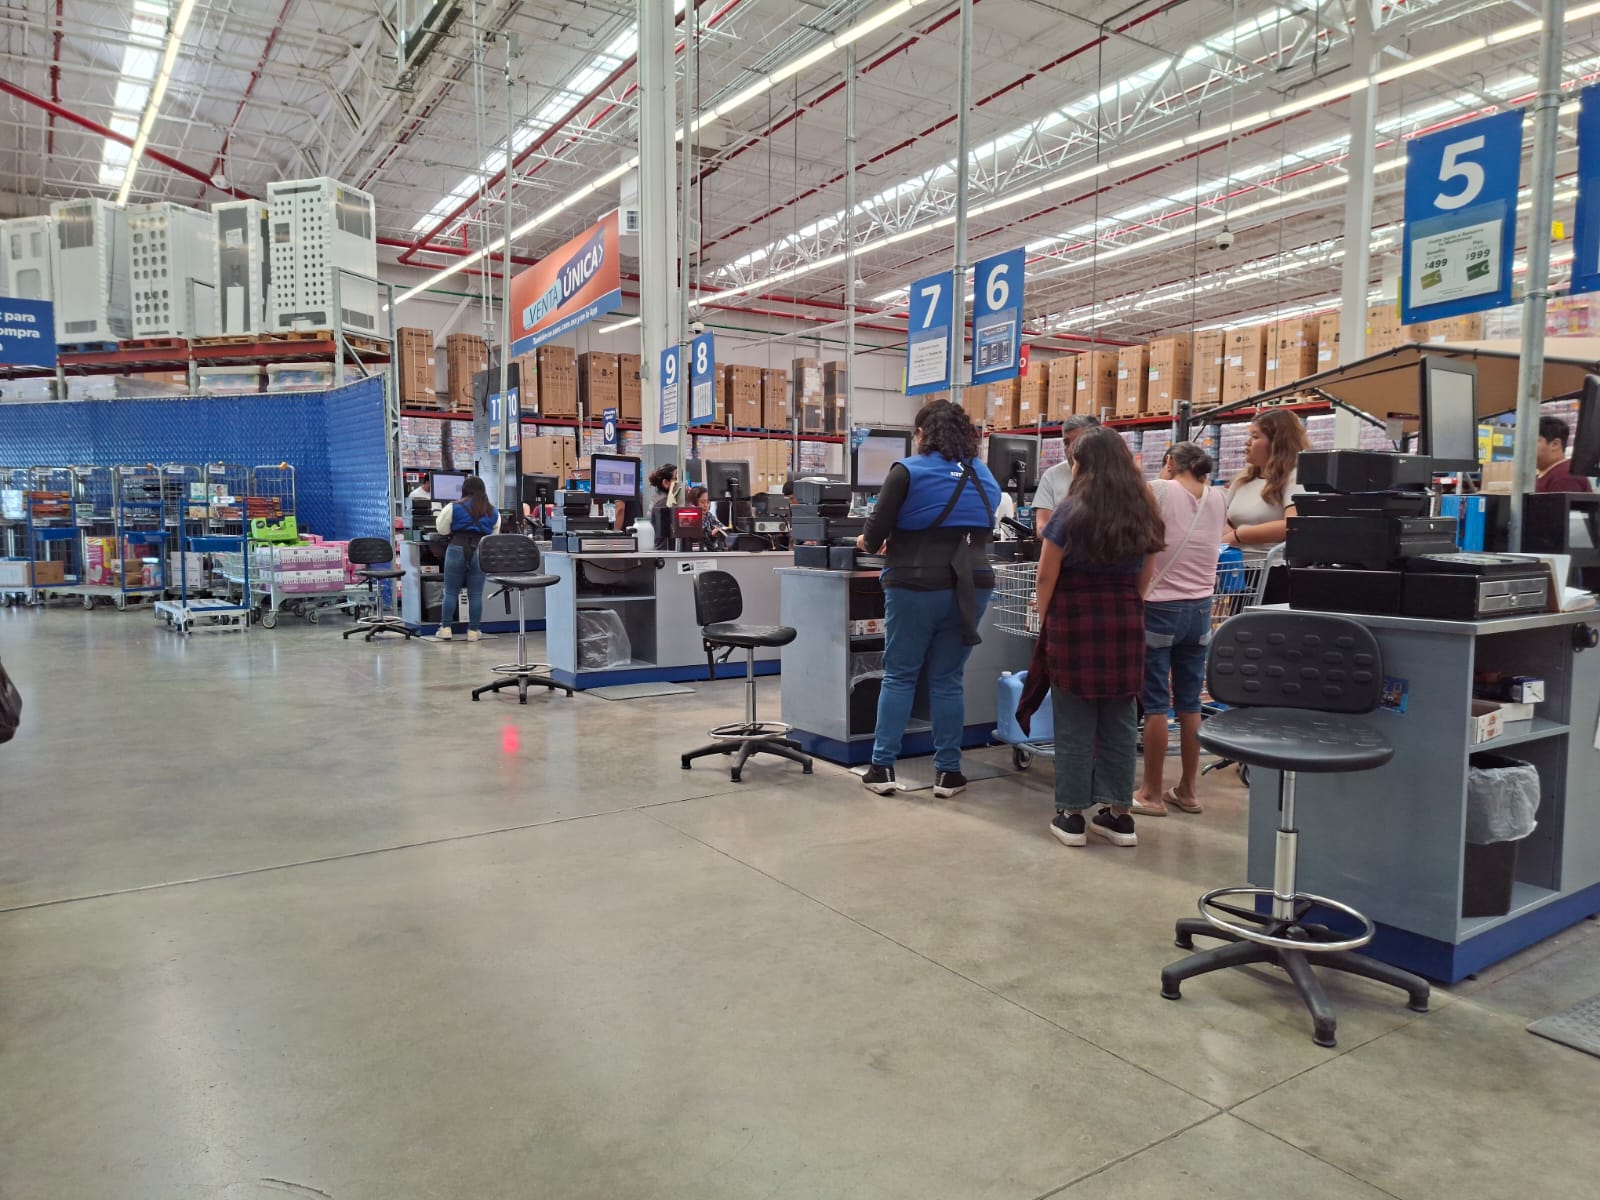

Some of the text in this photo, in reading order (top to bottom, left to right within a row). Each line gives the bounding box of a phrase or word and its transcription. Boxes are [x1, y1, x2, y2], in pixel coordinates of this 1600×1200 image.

[1433, 135, 1485, 210] 5
[1424, 258, 1448, 270] $499
[1466, 249, 1491, 261] $999
[529, 245, 598, 325] VENTA ÚNICA
[986, 264, 1009, 311] 6
[4, 312, 36, 323] para
[921, 284, 941, 329] 7
[666, 354, 676, 385] 9
[697, 342, 708, 374] 8
[491, 398, 501, 421] 11
[508, 394, 517, 417] 10
